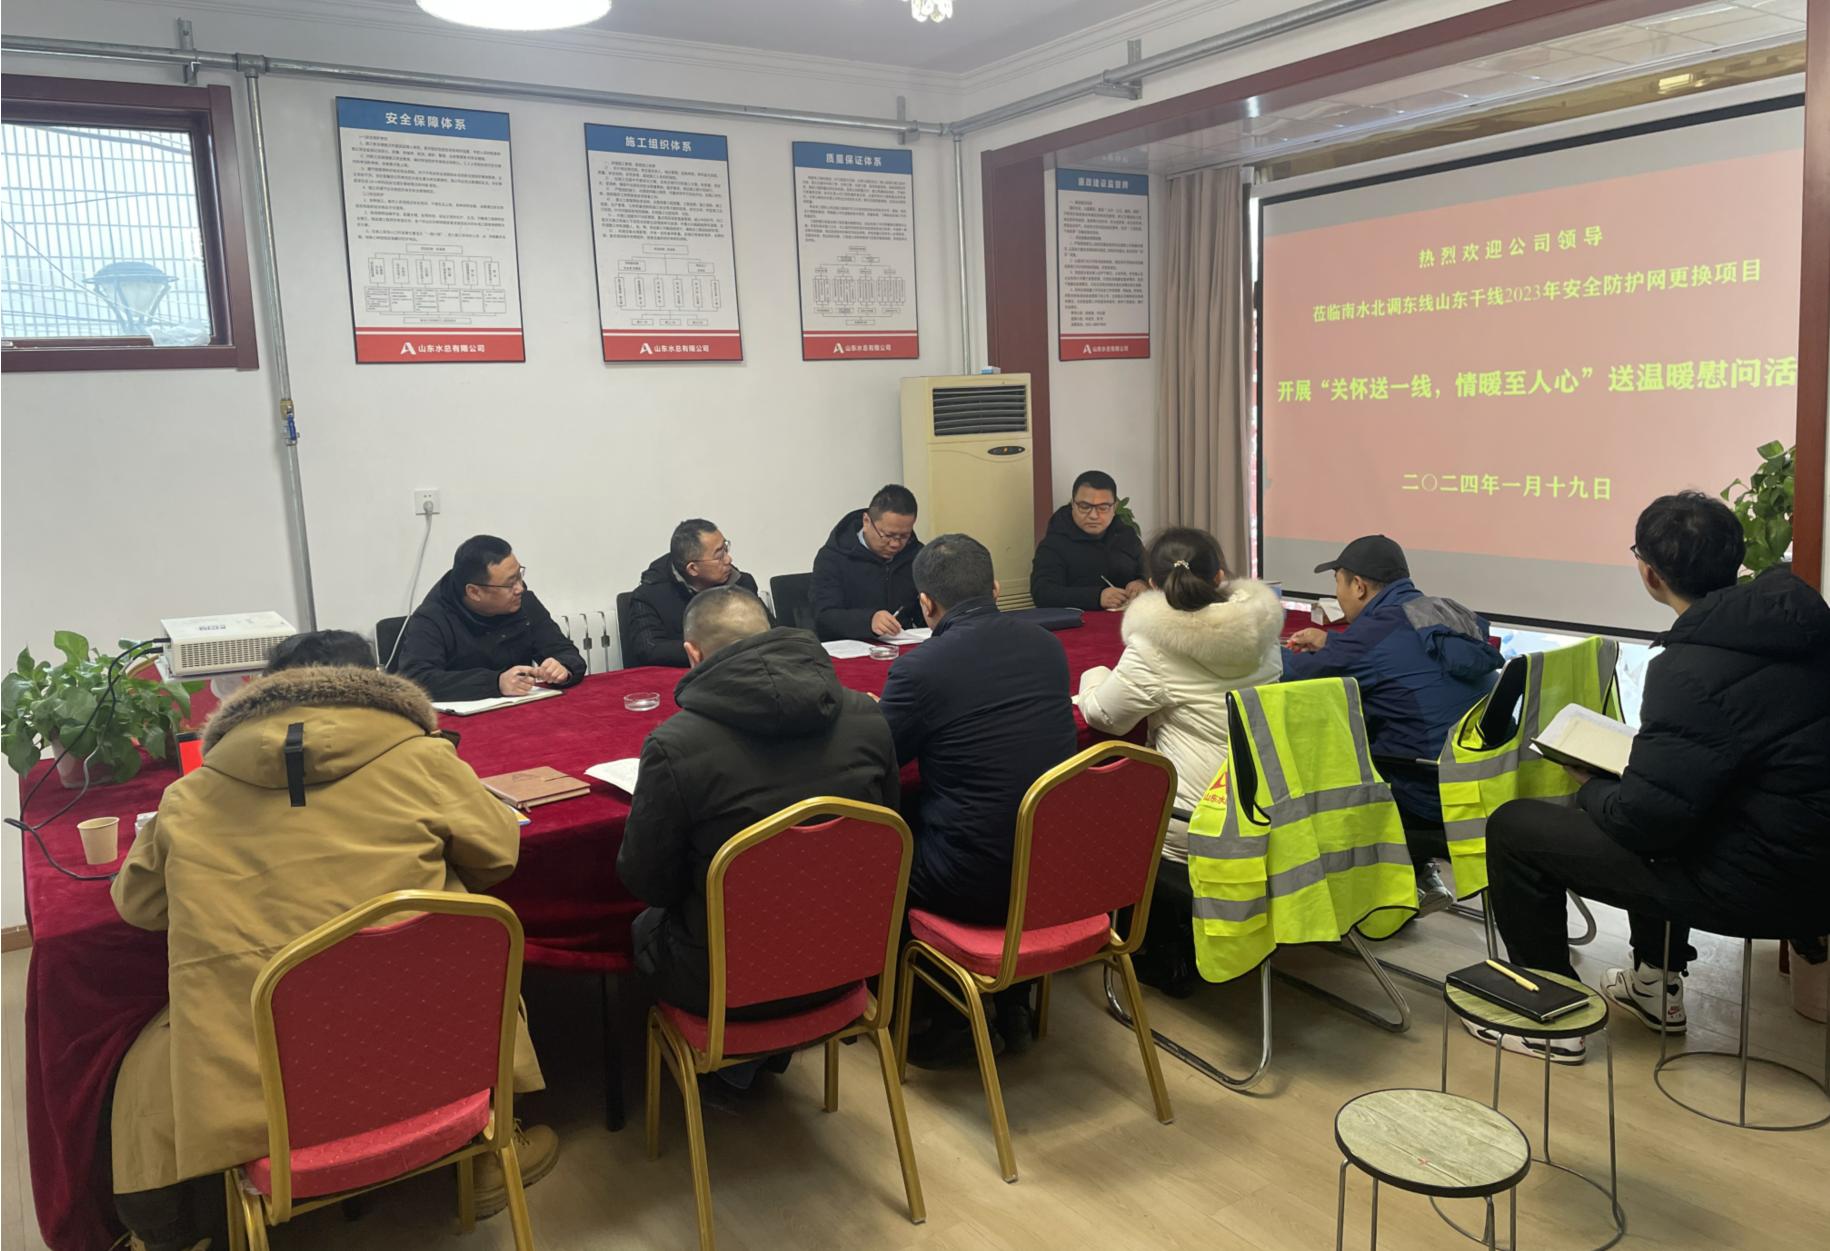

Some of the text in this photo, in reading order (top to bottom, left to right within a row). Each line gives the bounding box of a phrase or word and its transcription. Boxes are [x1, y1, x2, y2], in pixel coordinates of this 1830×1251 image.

[385, 112, 467, 131] 安全保障体系
[625, 135, 692, 153] 施工组织体系
[825, 152, 882, 167] 质量保证体系
[1418, 225, 1603, 269] 热烈欢迎公司领导
[1312, 258, 1761, 323] 莅临南水北调东线山东干线2023年安全防护网更换项目
[418, 344, 486, 354] 山东水总有限公司
